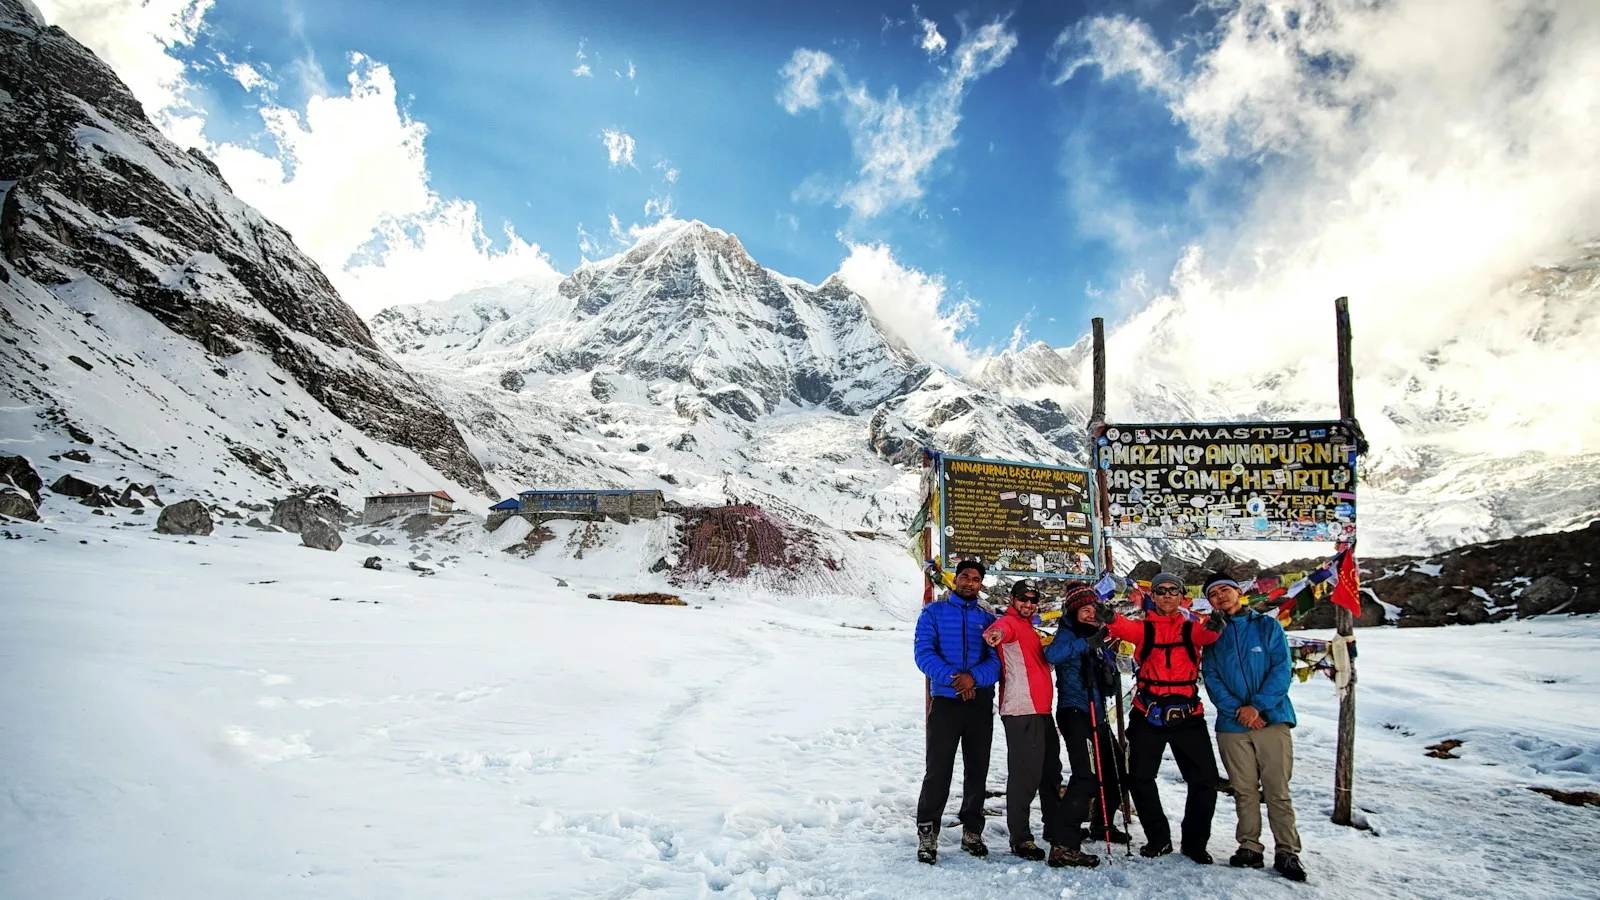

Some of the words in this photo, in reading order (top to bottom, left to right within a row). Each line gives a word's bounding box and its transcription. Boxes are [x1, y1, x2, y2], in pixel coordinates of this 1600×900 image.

[1150, 428, 1294, 440] NAMASTE
[1099, 444, 1201, 465] AMAZING
[1205, 443, 1349, 465] ANNAPURNA
[951, 461, 1008, 477] ANNAPURNA
[1009, 466, 1031, 479] BASE
[1031, 469, 1052, 481] CAMP
[1106, 469, 1160, 489] BASE
[1168, 469, 1237, 490] CAMP
